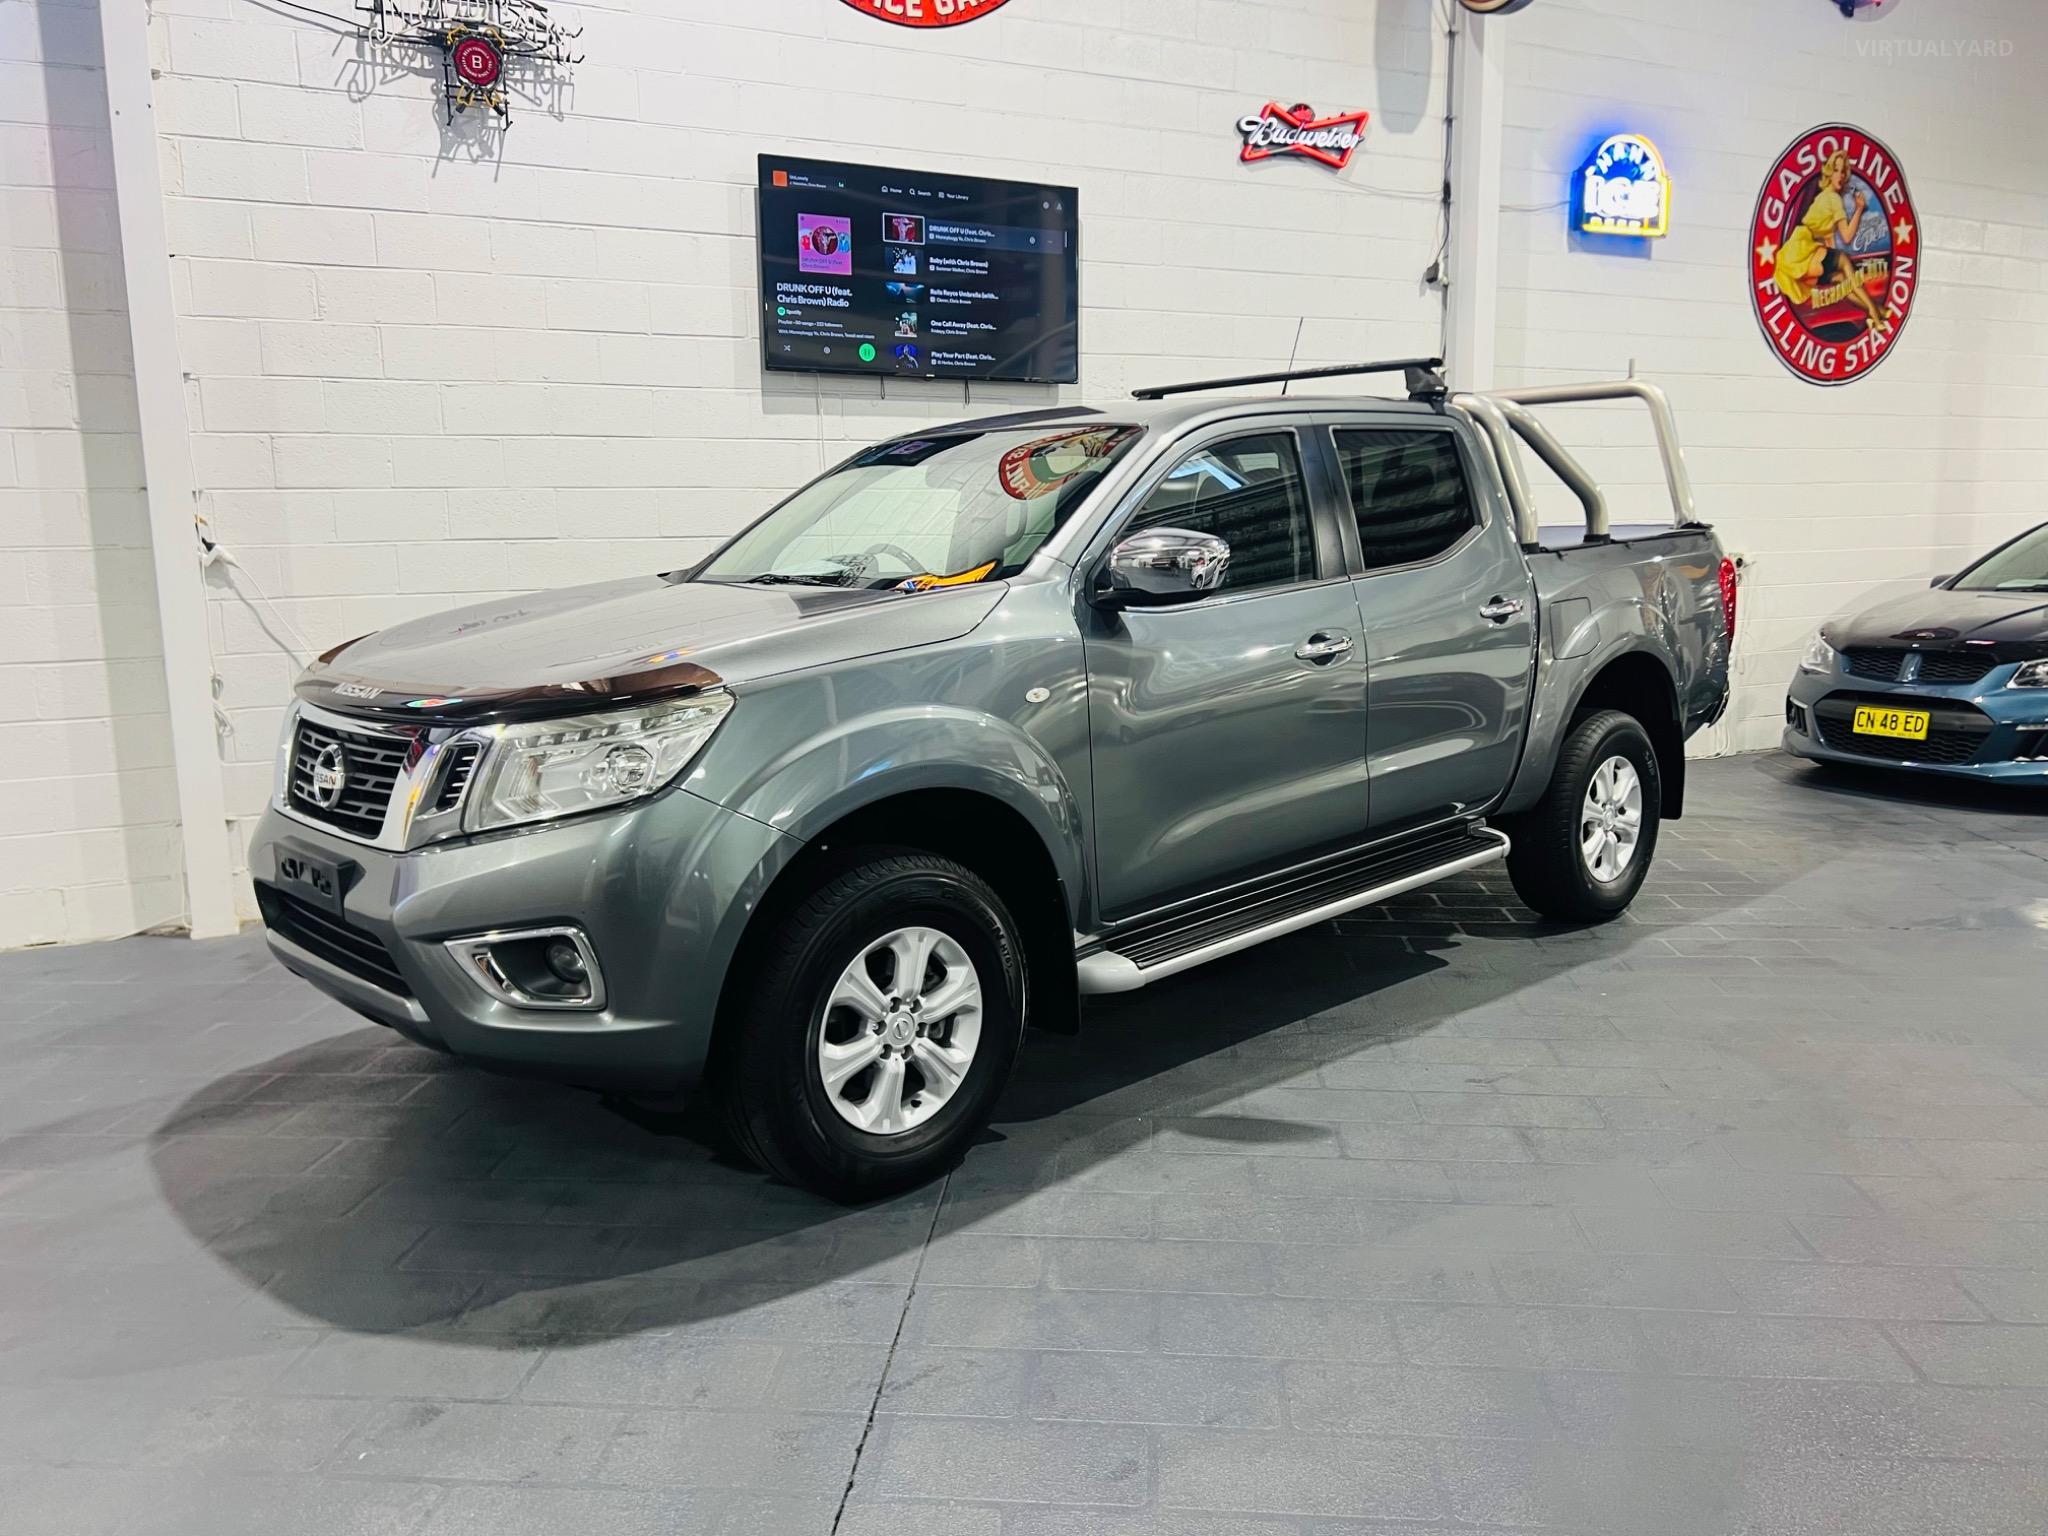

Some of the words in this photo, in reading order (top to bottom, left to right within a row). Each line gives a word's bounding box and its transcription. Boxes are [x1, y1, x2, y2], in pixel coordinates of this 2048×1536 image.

[472, 55, 482, 68] B
[1239, 115, 1363, 149] Budweiser
[1763, 136, 1905, 224] GASOLINE
[776, 282, 807, 293] DRUNK
[807, 284, 825, 295] OFF
[825, 286, 831, 295] U
[777, 294, 798, 305] Chris
[798, 296, 826, 307] Brown)
[826, 297, 850, 308] Radio
[1759, 277, 1837, 375] FILLING
[332, 682, 384, 699] NISSAN
[1856, 711, 1876, 729] CN
[1880, 713, 1899, 731] 48
[1903, 715, 1925, 733] ED
